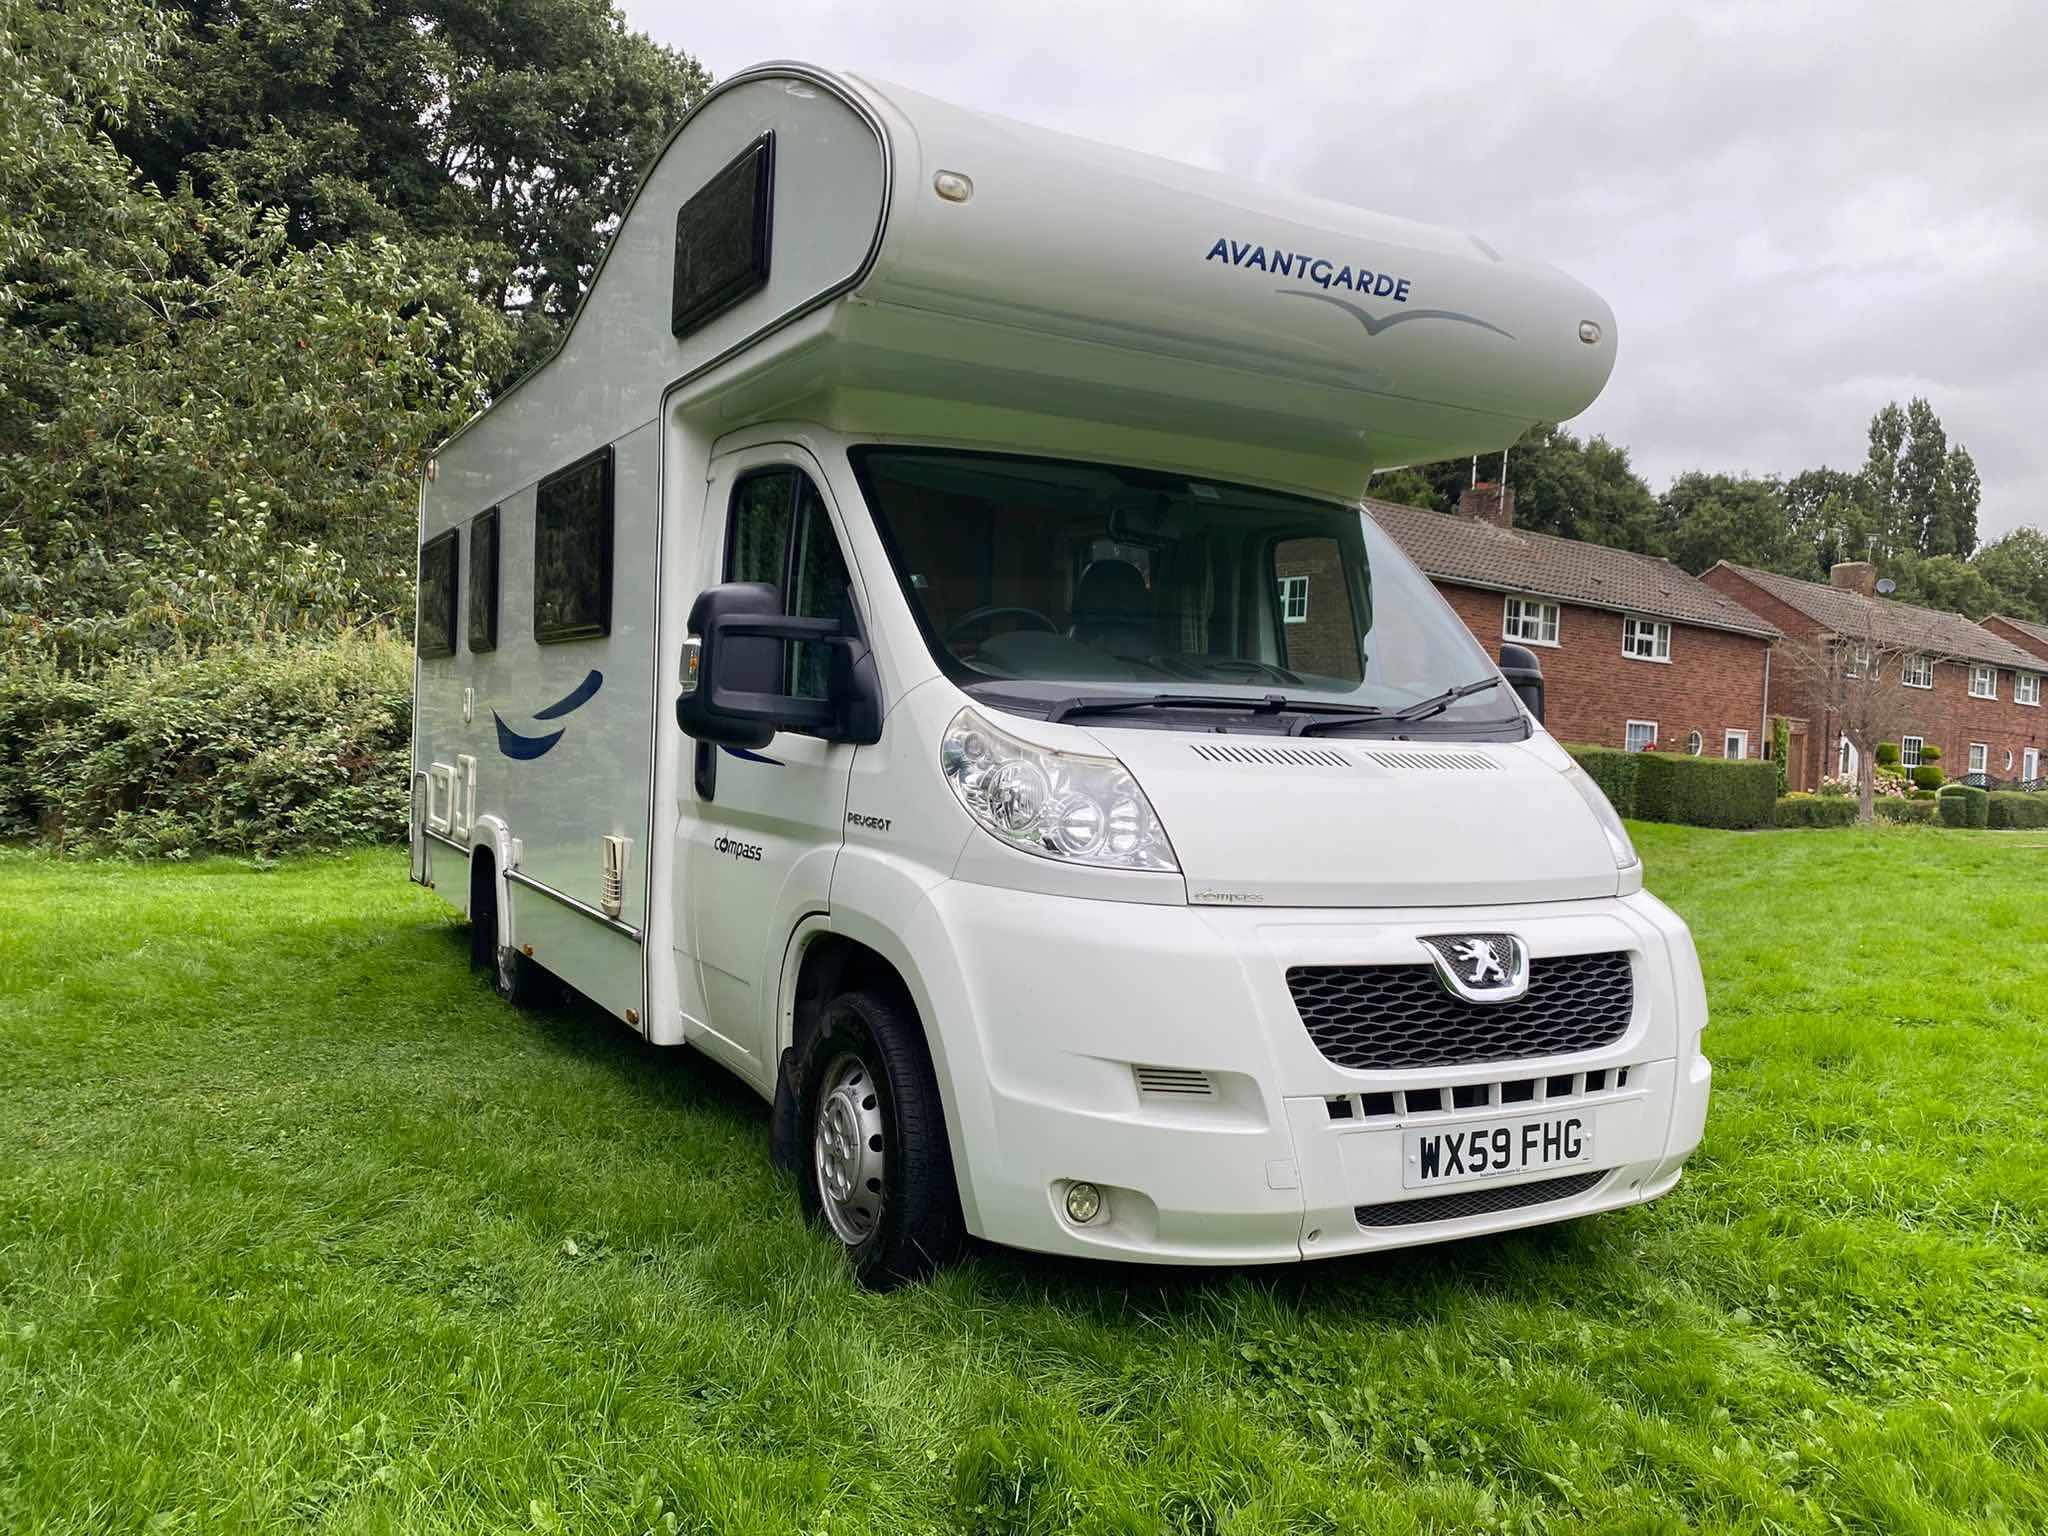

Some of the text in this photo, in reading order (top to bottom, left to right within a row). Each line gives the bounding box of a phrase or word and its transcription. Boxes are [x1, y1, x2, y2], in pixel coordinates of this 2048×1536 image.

[1205, 237, 1411, 302] AVANTGARDE
[847, 812, 892, 832] PEUGEOT
[714, 834, 763, 861] compass
[1420, 1118, 1582, 1179] WX59 FHG
